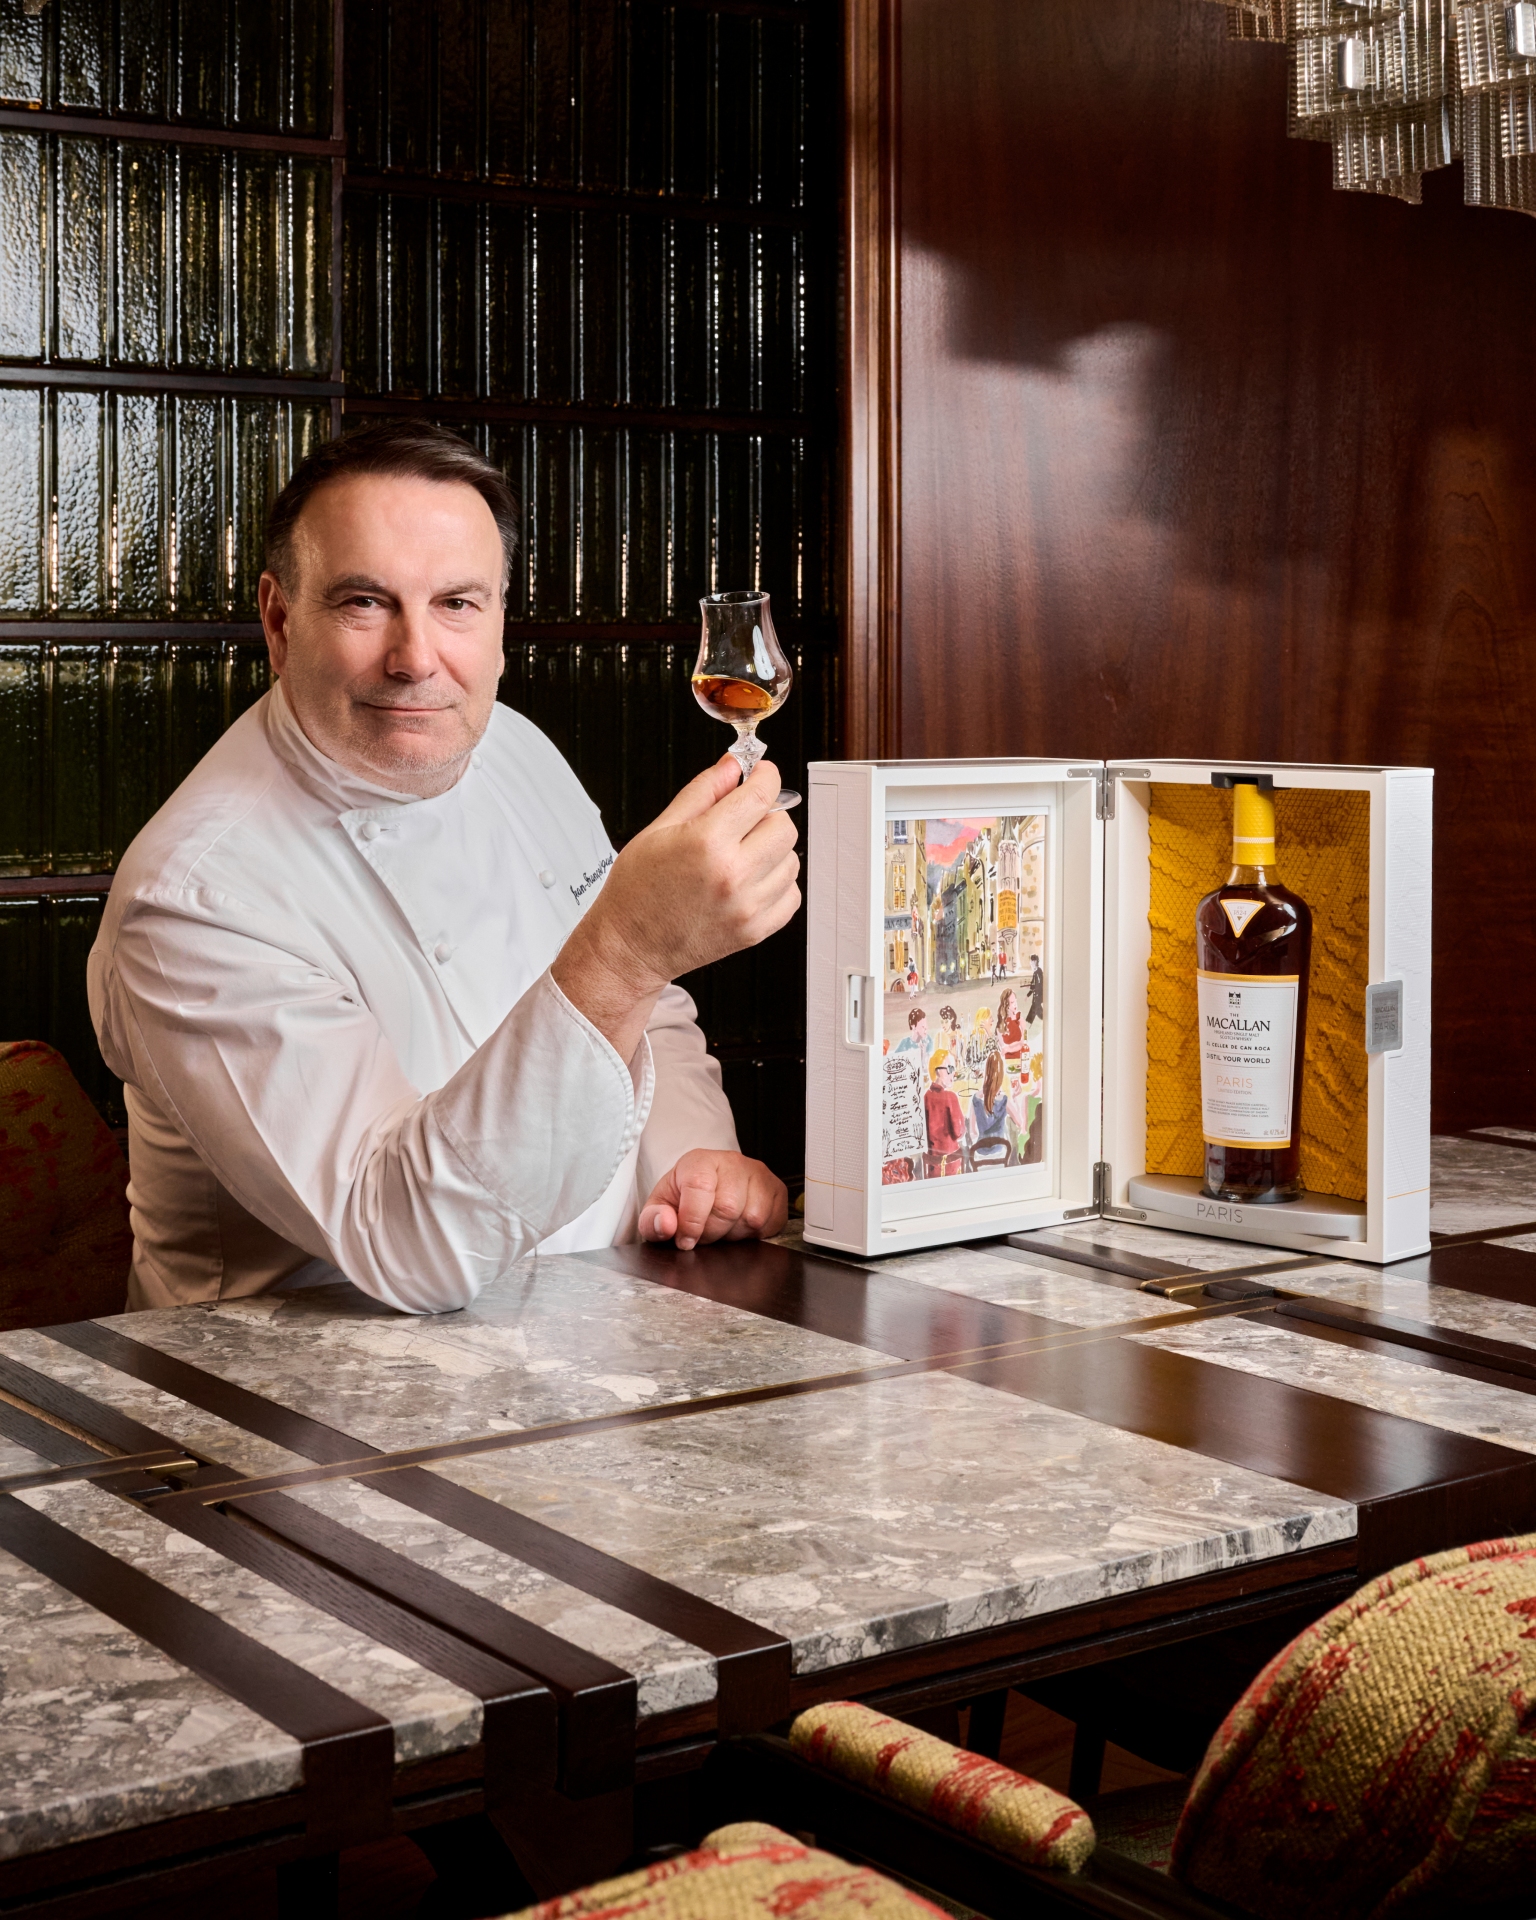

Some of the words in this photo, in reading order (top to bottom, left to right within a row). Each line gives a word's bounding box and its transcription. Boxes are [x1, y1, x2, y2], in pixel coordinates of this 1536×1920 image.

[1206, 1016, 1271, 1031] MACALLAN
[1374, 1020, 1396, 1032] PARIS
[1206, 1052, 1221, 1061] DISTIL
[1216, 1075, 1253, 1089] PARIS
[1197, 1203, 1243, 1224] PARIS
